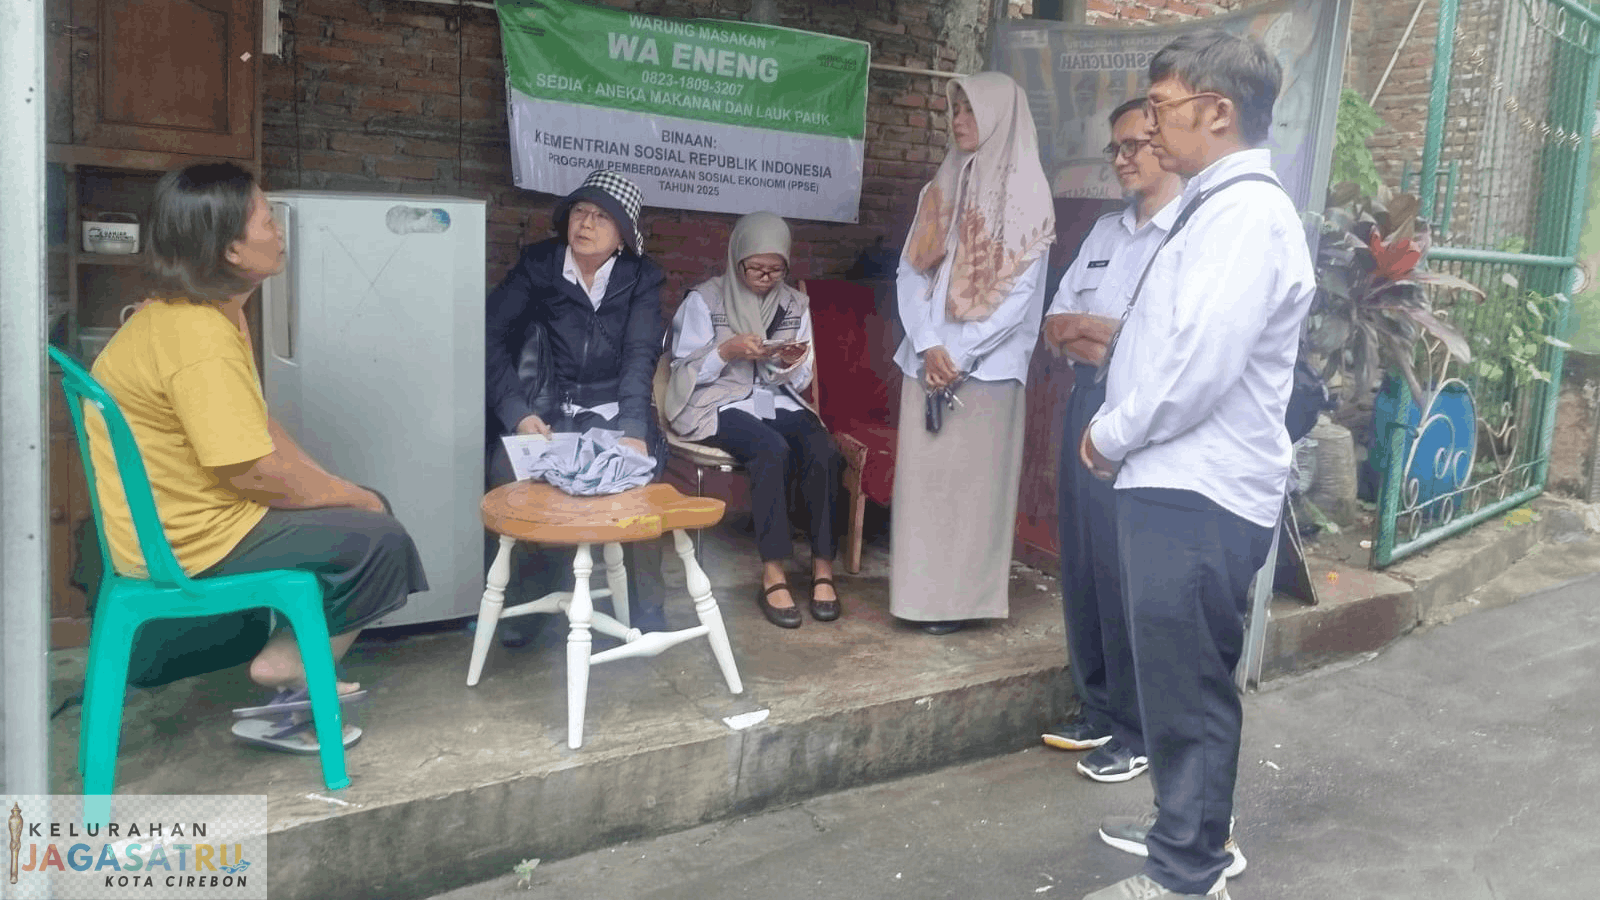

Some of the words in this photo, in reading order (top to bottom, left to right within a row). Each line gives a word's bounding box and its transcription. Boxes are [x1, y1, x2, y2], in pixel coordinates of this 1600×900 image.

[629, 14, 695, 37] WARUNG
[699, 27, 766, 50] MASAKAN
[608, 32, 660, 65] WA
[672, 42, 778, 83] ENENG
[536, 73, 583, 92] SEDIA
[595, 82, 646, 101] ANEKA
[649, 89, 721, 112] MAKANAN
[725, 101, 753, 117] DAN
[756, 106, 792, 121] LAUK
[795, 111, 831, 126] PAUK
[641, 70, 744, 96] 0823-1809-3207
[535, 129, 629, 156] KEMENTRIAN
[634, 144, 686, 164] SOSIAL
[689, 151, 757, 172] REPUBLIK
[761, 160, 832, 179] INDONESIA
[661, 129, 717, 149] BINAAN:
[549, 153, 604, 169] PROGRAM
[607, 161, 696, 180] PEMBERDAYAAN
[699, 170, 736, 185] SOSIAL
[738, 175, 786, 189] EKONOMI
[787, 179, 819, 194] (PPSE)
[659, 180, 694, 194] TAHUN
[697, 184, 720, 196] 2025
